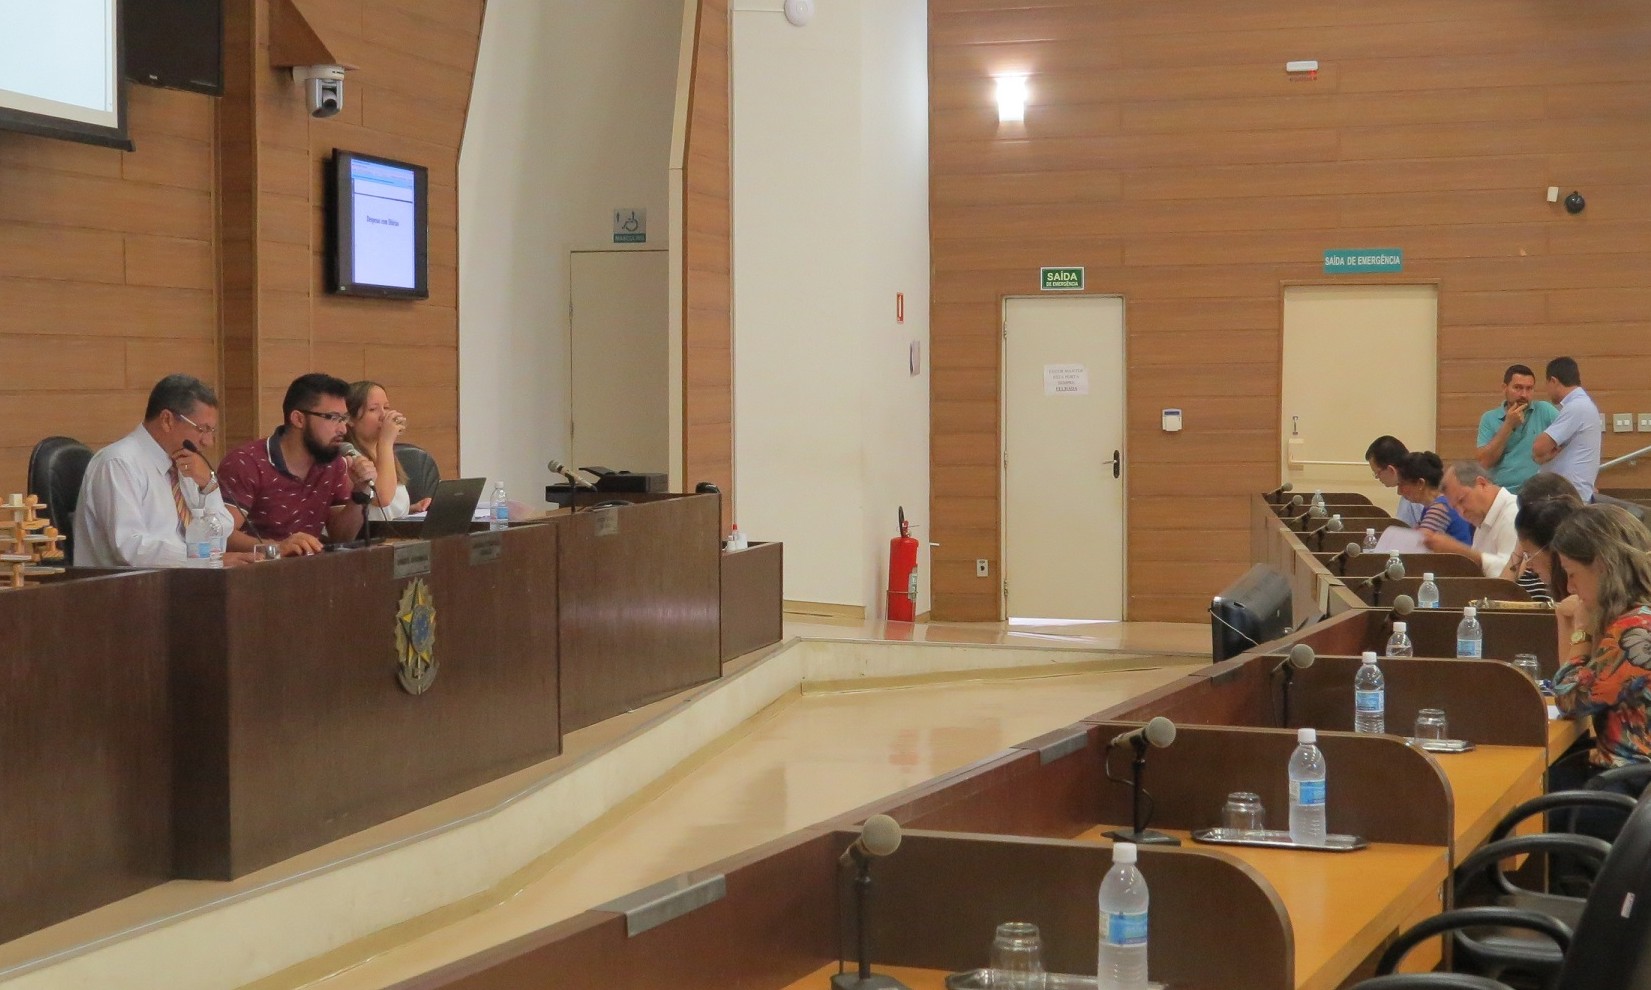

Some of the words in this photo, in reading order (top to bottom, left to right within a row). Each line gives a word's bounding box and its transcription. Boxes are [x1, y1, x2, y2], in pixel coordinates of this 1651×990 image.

[1325, 255, 1345, 265] SAÍDA
[1346, 256, 1357, 266] DE
[1358, 254, 1400, 265] EMERGÊNCIA
[1046, 270, 1078, 281] SAÍDA
